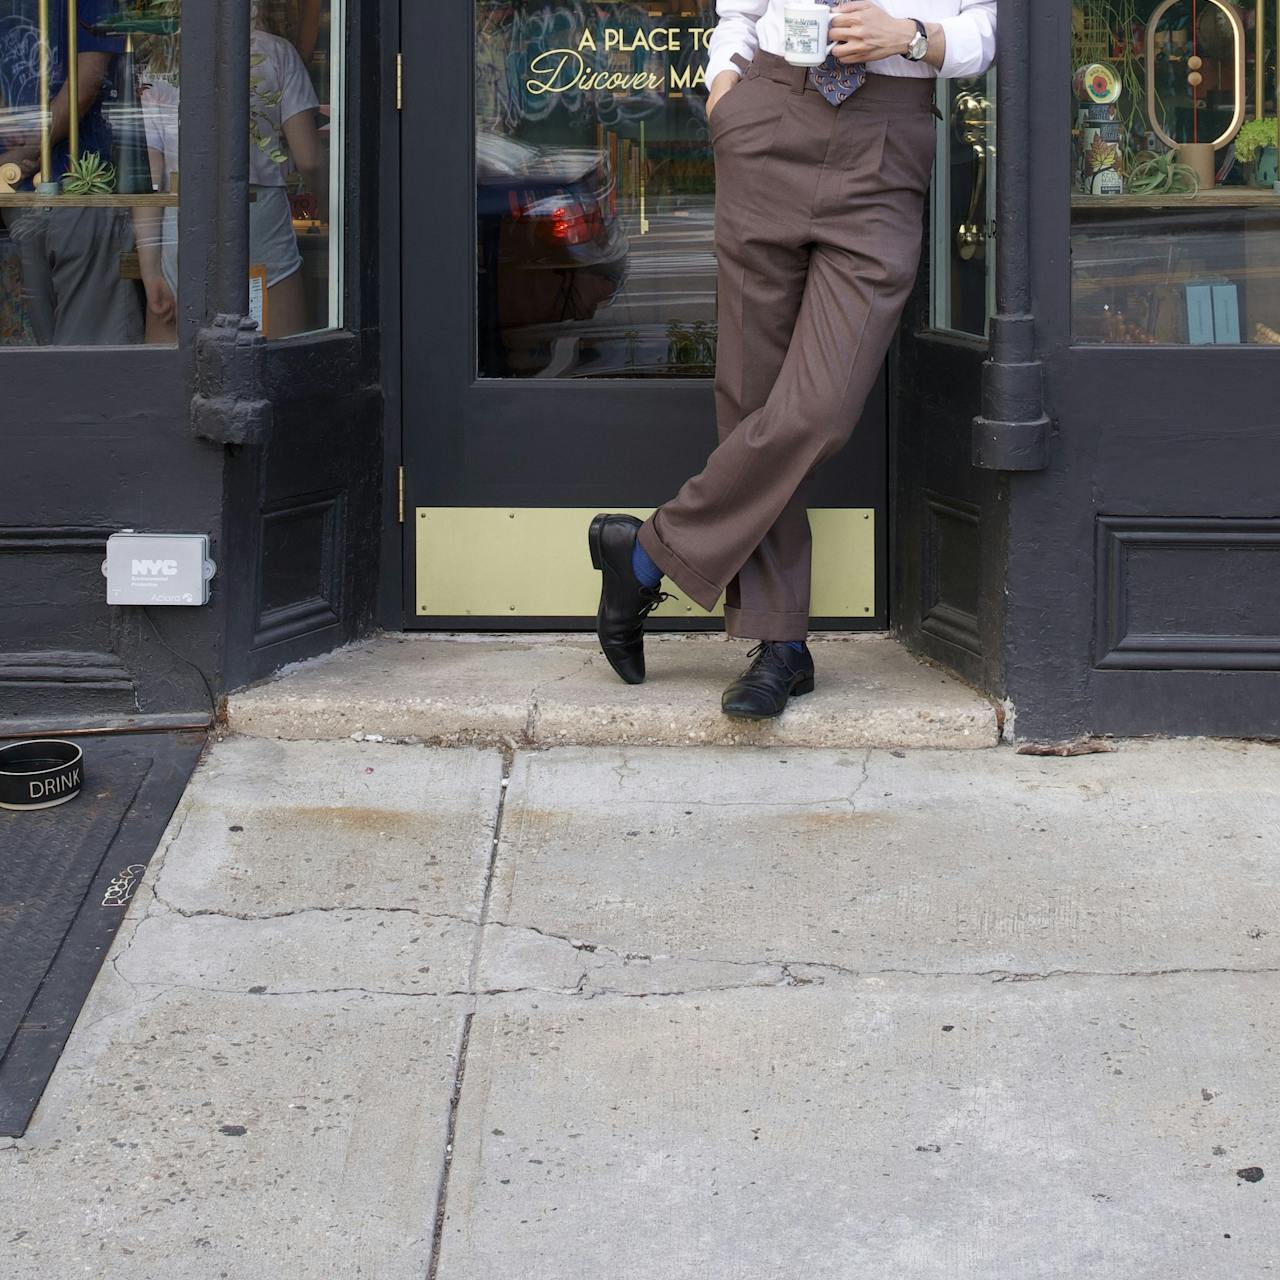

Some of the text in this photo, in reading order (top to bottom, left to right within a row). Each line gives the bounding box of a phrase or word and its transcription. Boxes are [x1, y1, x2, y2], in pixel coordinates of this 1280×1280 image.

[577, 27, 597, 51] A
[604, 27, 681, 52] PLACE
[526, 48, 665, 95] Discover
[131, 559, 179, 576] NYC
[28, 767, 82, 799] DRINK
